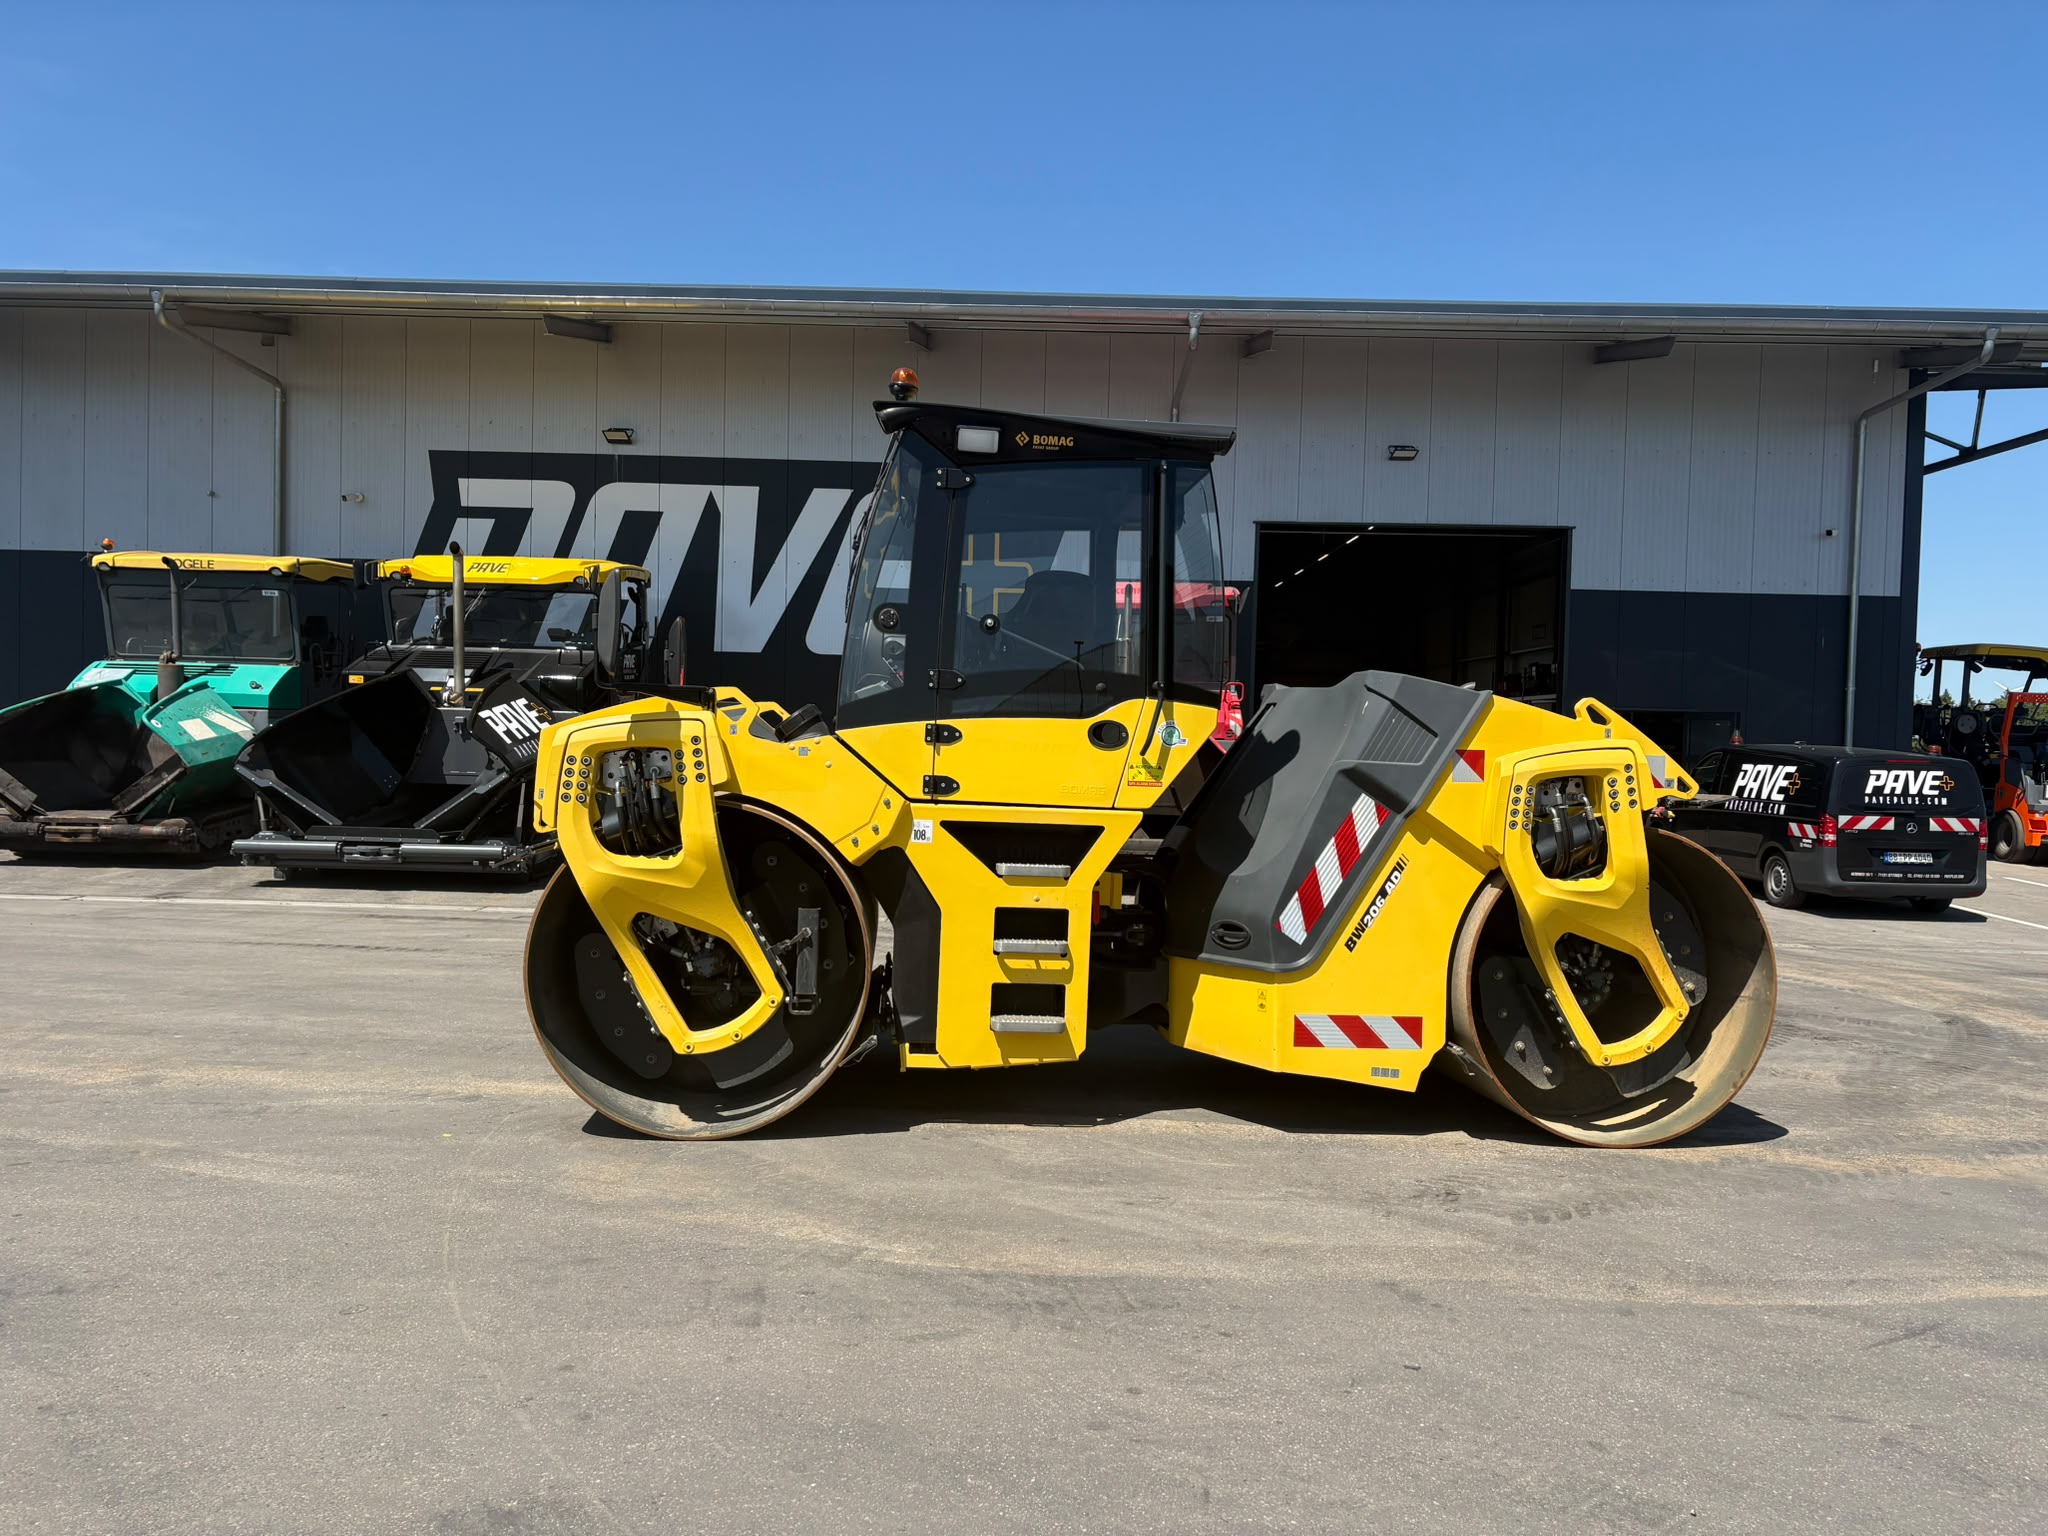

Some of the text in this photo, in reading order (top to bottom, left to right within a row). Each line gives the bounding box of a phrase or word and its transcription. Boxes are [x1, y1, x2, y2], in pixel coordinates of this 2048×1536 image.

[1033, 434, 1074, 447] BOMAG
[467, 562, 512, 573] PAVE
[1864, 796, 1948, 806] PAVEPLUS.COM
[1724, 800, 1786, 816] PAVEPLUS.COM
[913, 829, 926, 841] 108
